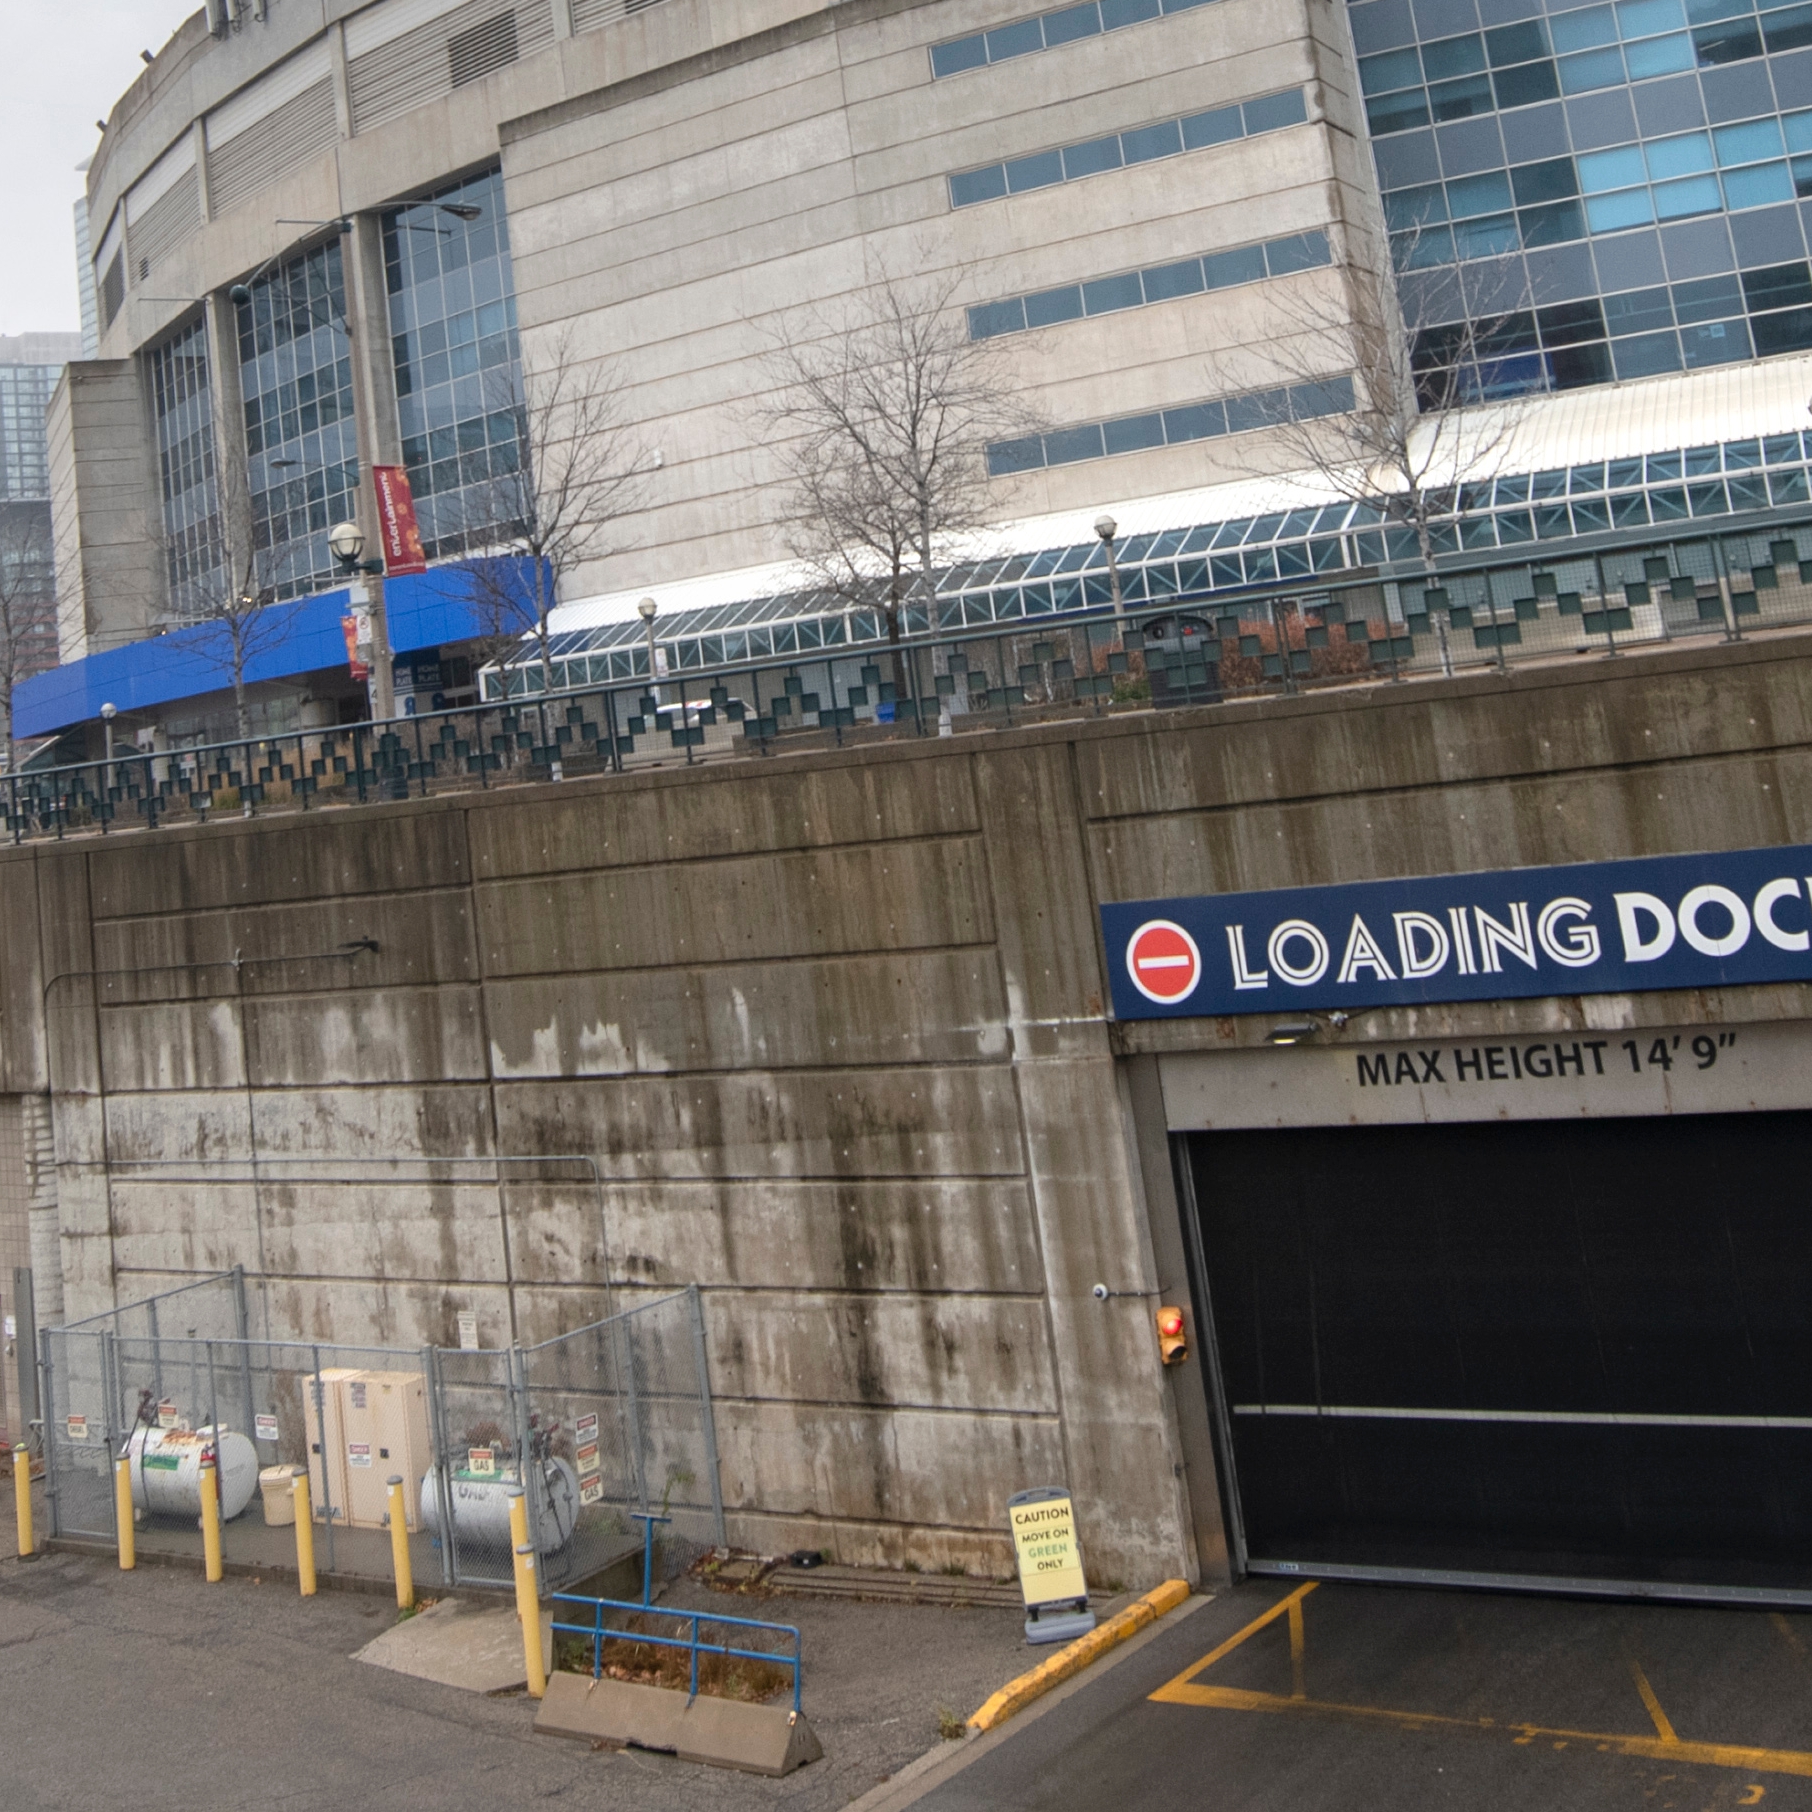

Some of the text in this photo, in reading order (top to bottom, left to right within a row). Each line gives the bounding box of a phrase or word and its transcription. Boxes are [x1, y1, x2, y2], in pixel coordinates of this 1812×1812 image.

[1225, 897, 1601, 989] LOADING
[1356, 1050, 1446, 1087] MAX
[1454, 1041, 1608, 1082] HEIGHT
[1622, 1036, 1681, 1073] 14'
[474, 1459, 490, 1471] GAS
[584, 1485, 599, 1501] GAS
[1015, 1507, 1069, 1524] CAUTION
[1022, 1528, 1069, 1543] MOVE ON
[1028, 1543, 1068, 1558] GREEN
[1037, 1559, 1063, 1570] ONLY
